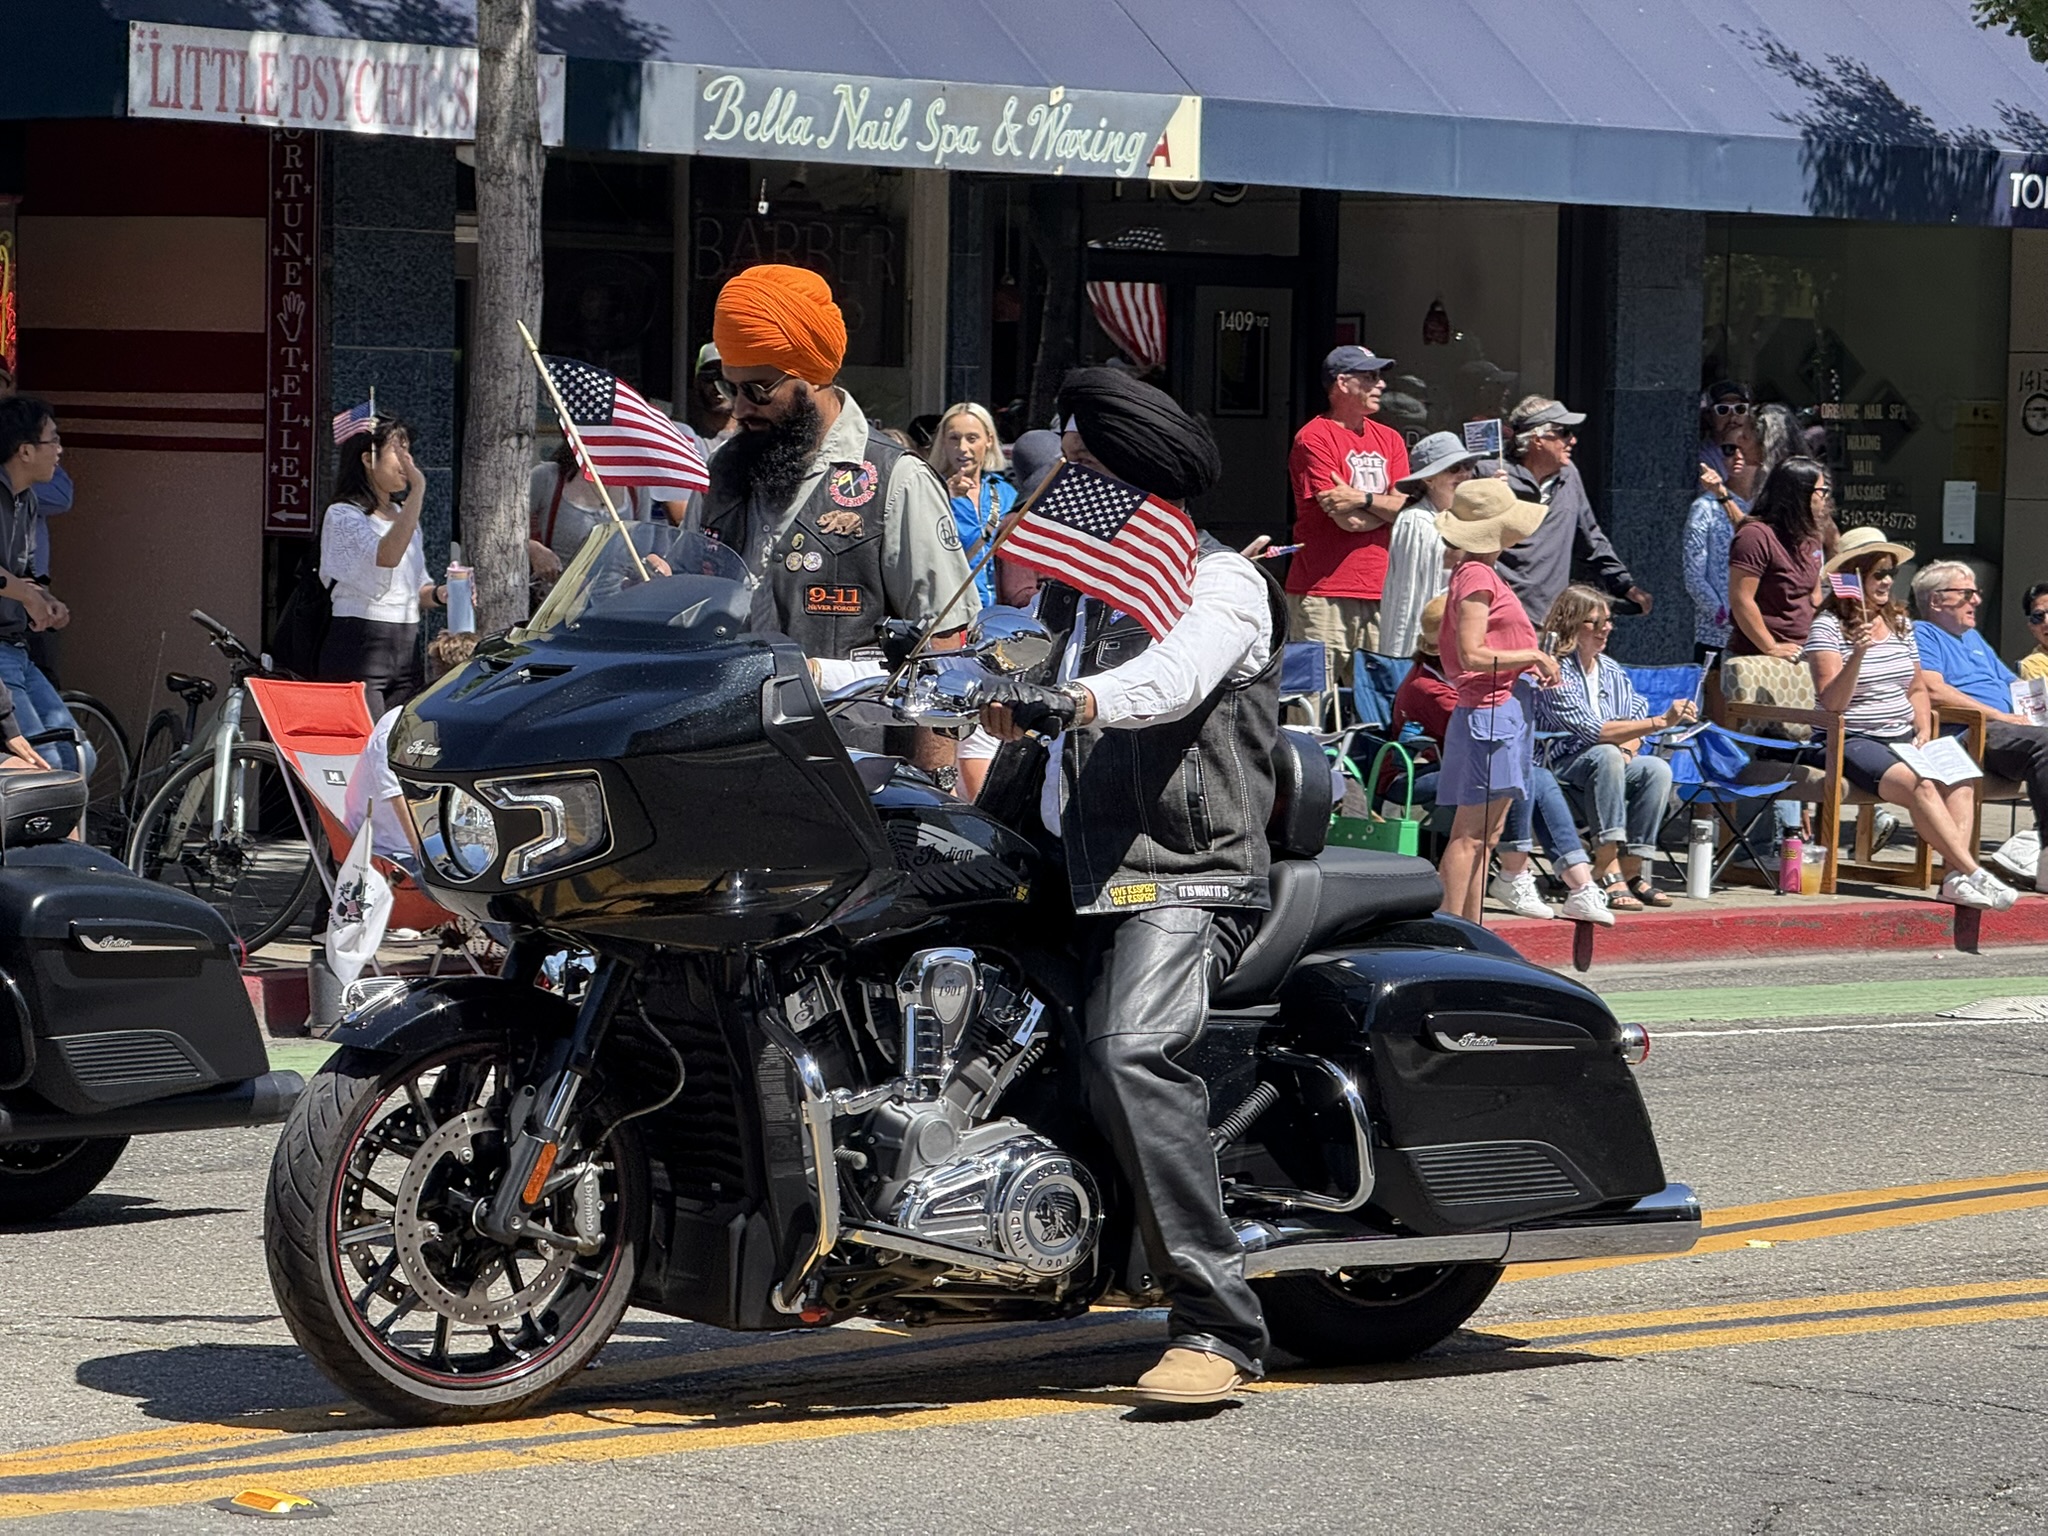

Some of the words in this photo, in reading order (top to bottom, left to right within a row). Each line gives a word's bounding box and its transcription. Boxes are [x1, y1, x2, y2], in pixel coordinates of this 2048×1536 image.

[149, 43, 279, 117] LITTLE
[289, 54, 440, 129] PSYCHIC
[703, 75, 814, 146] Bella
[816, 84, 913, 152] Nail
[915, 96, 982, 166] Spa
[991, 95, 1023, 156] &
[1026, 103, 1147, 178] Waxing
[2009, 172, 2048, 209] TO
[1219, 310, 1254, 331] 1409
[1820, 403, 1859, 419] ORGANIC
[1864, 403, 1883, 420] NAIL
[1889, 404, 1907, 420] SPA
[277, 346, 302, 505] TELLER
[1847, 435, 1881, 450] WAXING
[1852, 460, 1874, 476] NAIL
[832, 490, 875, 507] AMERICA
[1844, 484, 1887, 500] MASSAGE
[809, 587, 860, 604] 9-11
[913, 843, 973, 866] Indian
[1110, 886, 1127, 897] GIVE
[1127, 883, 1156, 896] RESPECT
[1113, 895, 1126, 905] GET
[1128, 892, 1156, 903] RESPECT
[1178, 886, 1187, 897] IT
[1187, 886, 1195, 896] IS
[1194, 885, 1214, 897] WHAT
[1214, 885, 1221, 897] IT
[1222, 886, 1230, 897] IS
[939, 985, 961, 996] 1901
[1458, 1033, 1498, 1047] Indian
[584, 1184, 595, 1231] brembo
